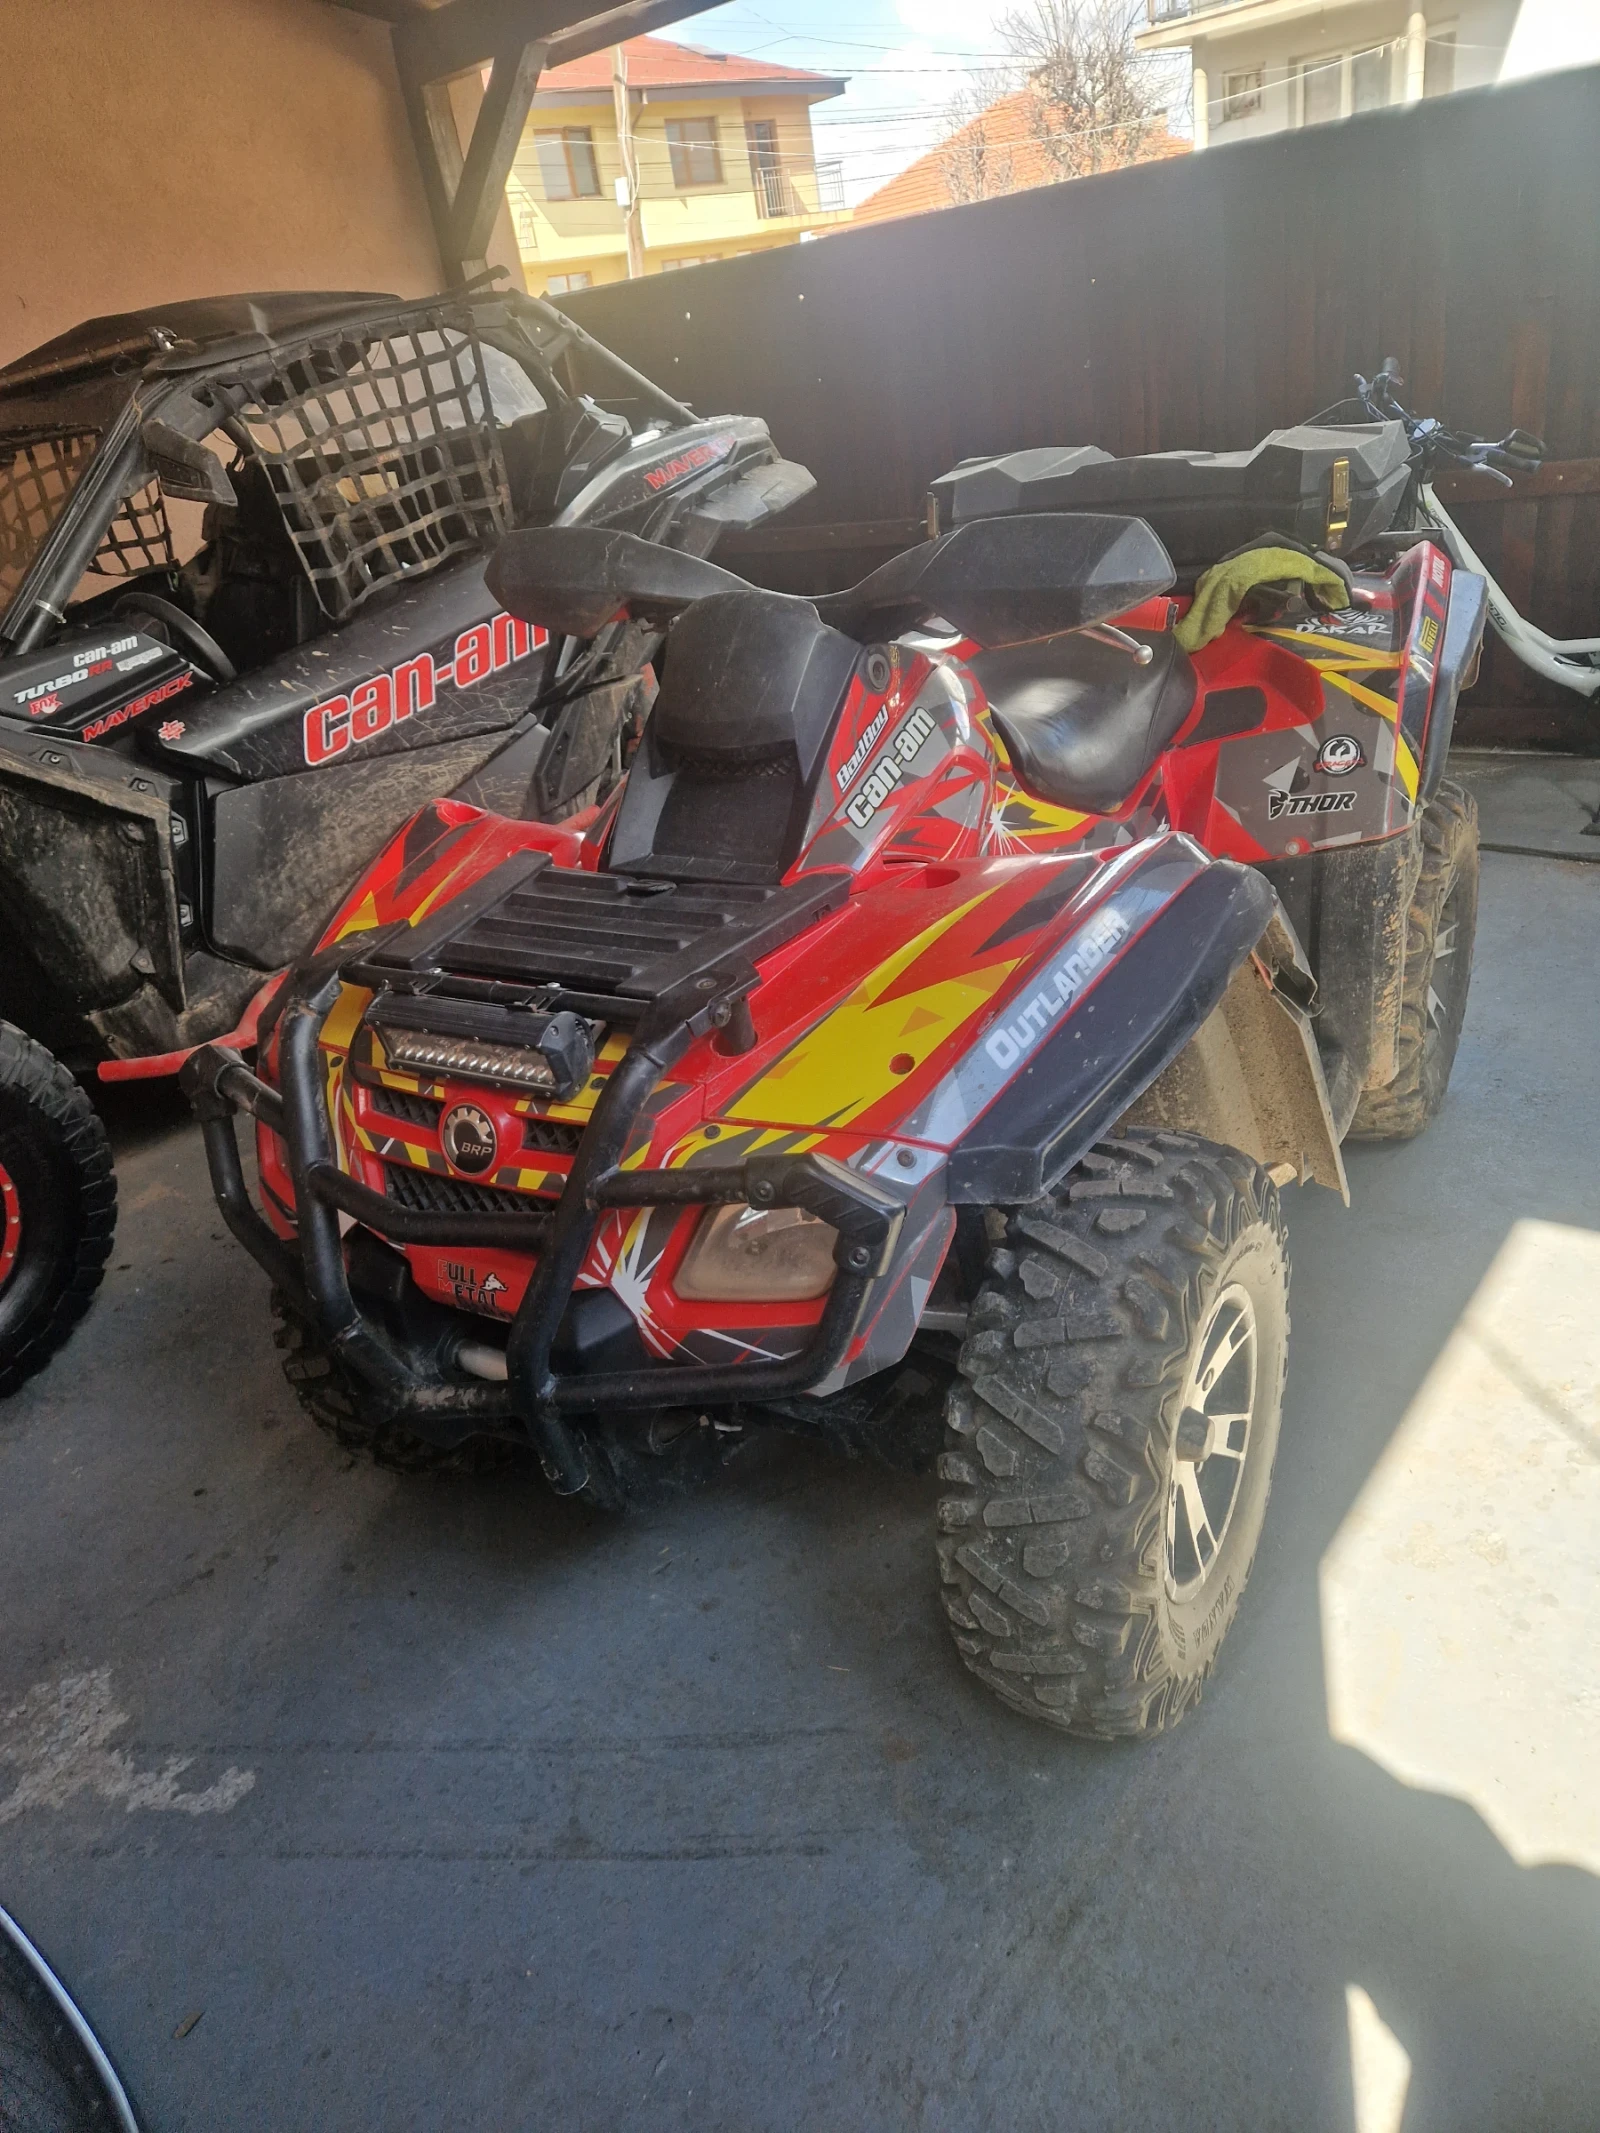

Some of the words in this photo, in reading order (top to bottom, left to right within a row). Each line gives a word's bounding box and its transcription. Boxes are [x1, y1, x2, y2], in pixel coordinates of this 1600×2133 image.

[1296, 621, 1392, 635] DAKAR
[1419, 616, 1439, 653] PIRELLI
[73, 635, 139, 667] can-am
[82, 671, 194, 743] MAVERICK
[836, 703, 889, 791] BadBoy
[845, 706, 937, 829] can-am
[1286, 790, 1358, 816] THOR
[985, 907, 1131, 1070] OUTLANDER
[461, 1142, 493, 1157] BRP
